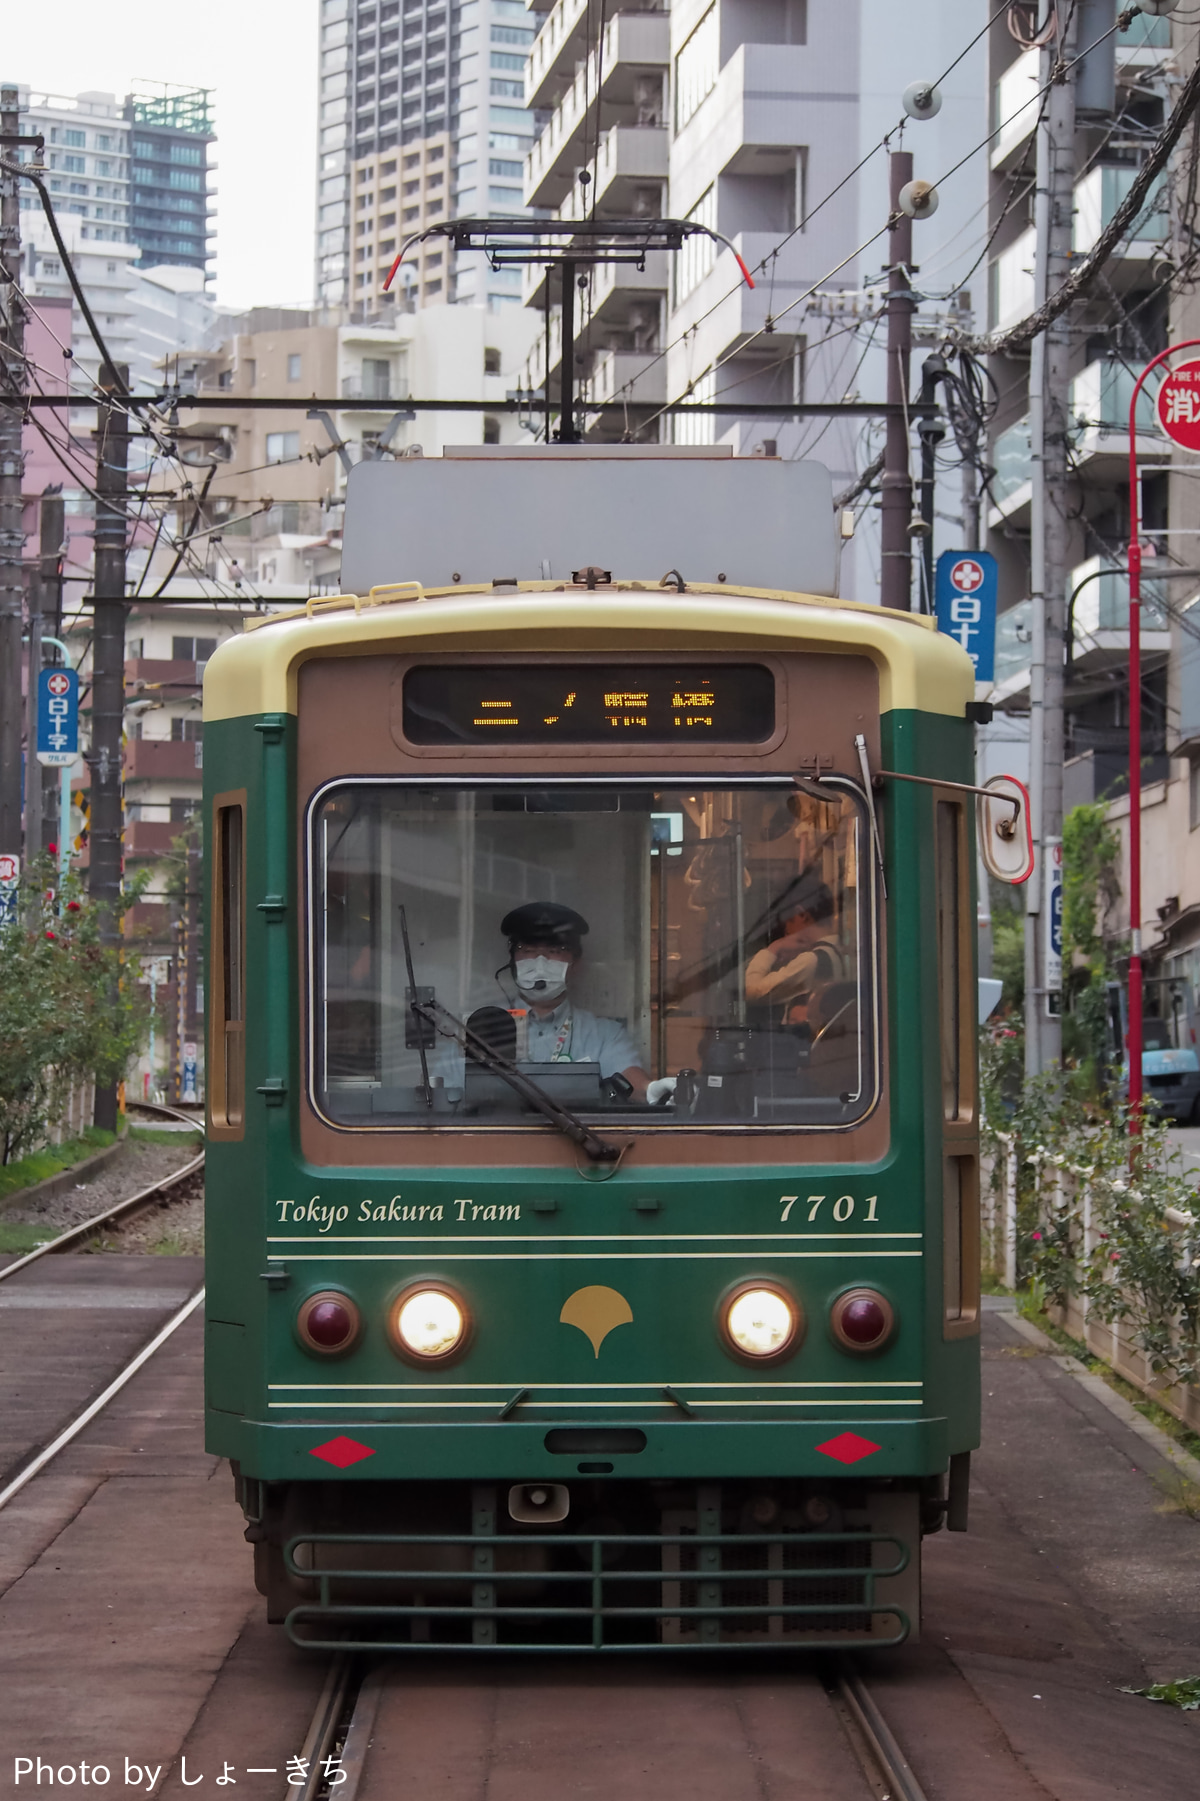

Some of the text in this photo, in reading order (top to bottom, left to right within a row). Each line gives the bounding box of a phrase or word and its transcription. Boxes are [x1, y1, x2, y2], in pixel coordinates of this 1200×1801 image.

[1172, 371, 1192, 382] FIRE
[48, 696, 68, 751] 白十字
[276, 1195, 521, 1233] Tokyo Sakura Tram
